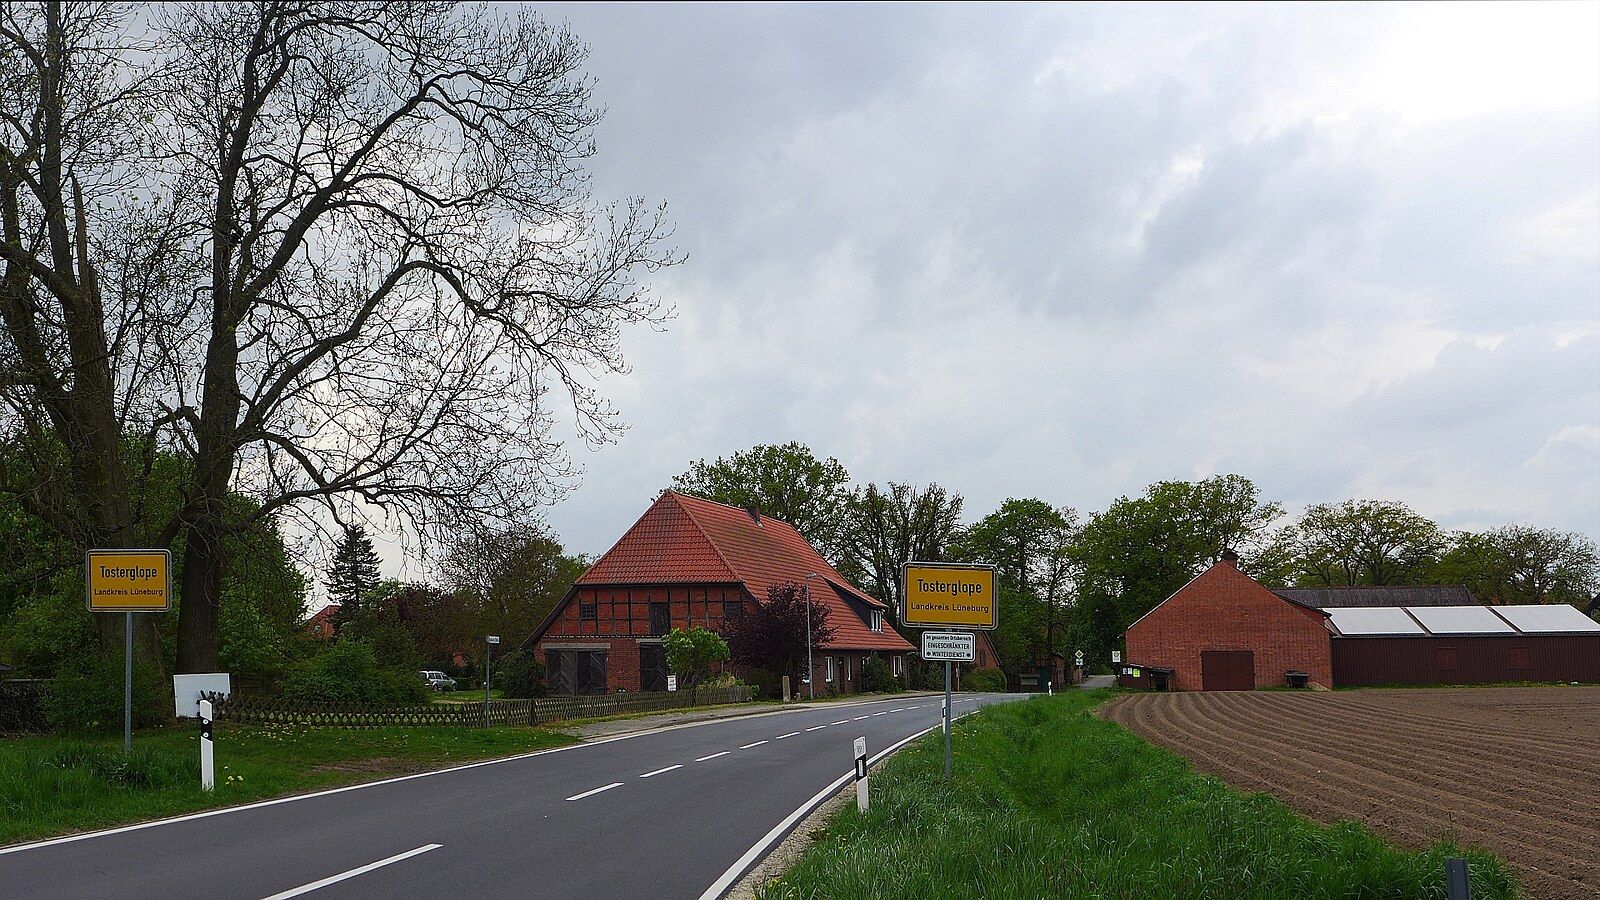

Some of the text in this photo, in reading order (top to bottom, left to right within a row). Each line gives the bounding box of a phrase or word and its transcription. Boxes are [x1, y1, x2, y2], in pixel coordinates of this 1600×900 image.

[100, 566, 157, 581] Tosterglope
[94, 588, 163, 597] Landkreis Lüneburg
[917, 579, 982, 596] Tosterglope
[911, 602, 989, 613] Landkreis Lüneburg
[928, 642, 970, 650] EINGESCHRÄNKTER
